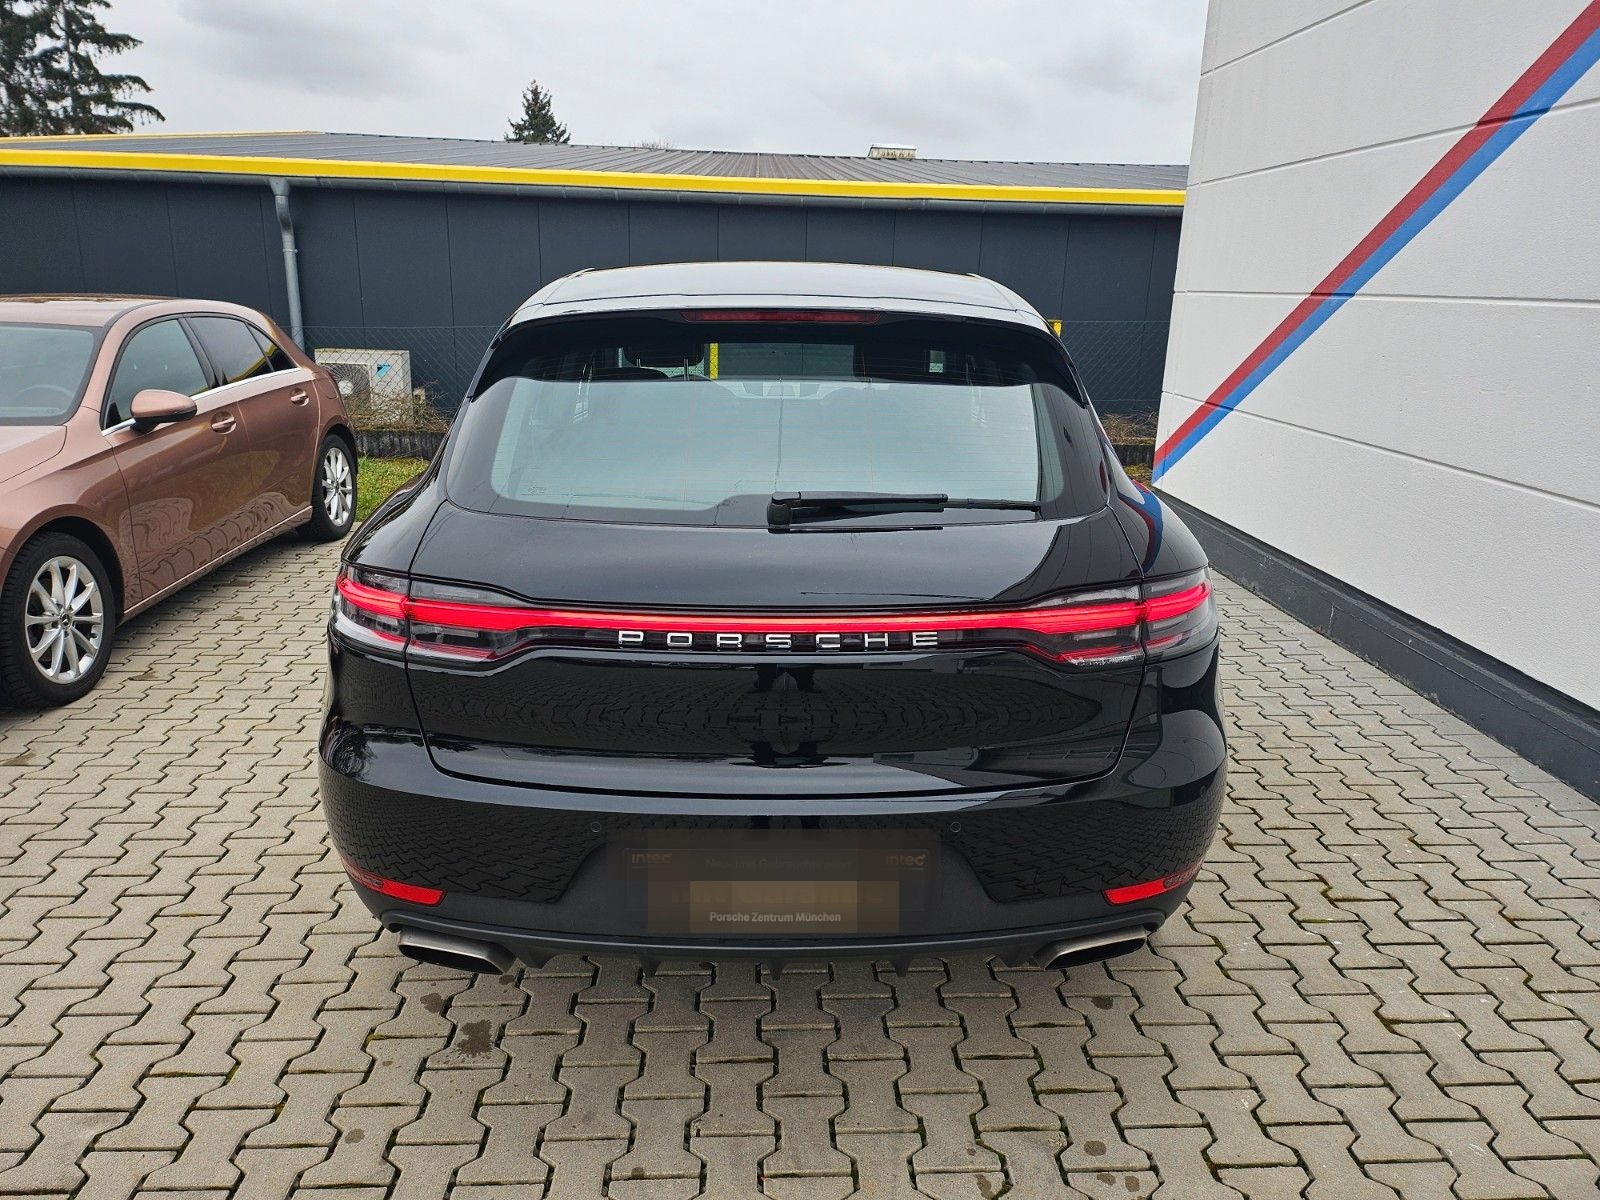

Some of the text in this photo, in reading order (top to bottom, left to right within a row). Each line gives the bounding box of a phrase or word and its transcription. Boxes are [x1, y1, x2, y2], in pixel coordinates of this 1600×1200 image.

[618, 630, 938, 649] PORSCHE
[735, 858, 756, 869] und
[710, 911, 841, 922] Porsche Zentrum München
